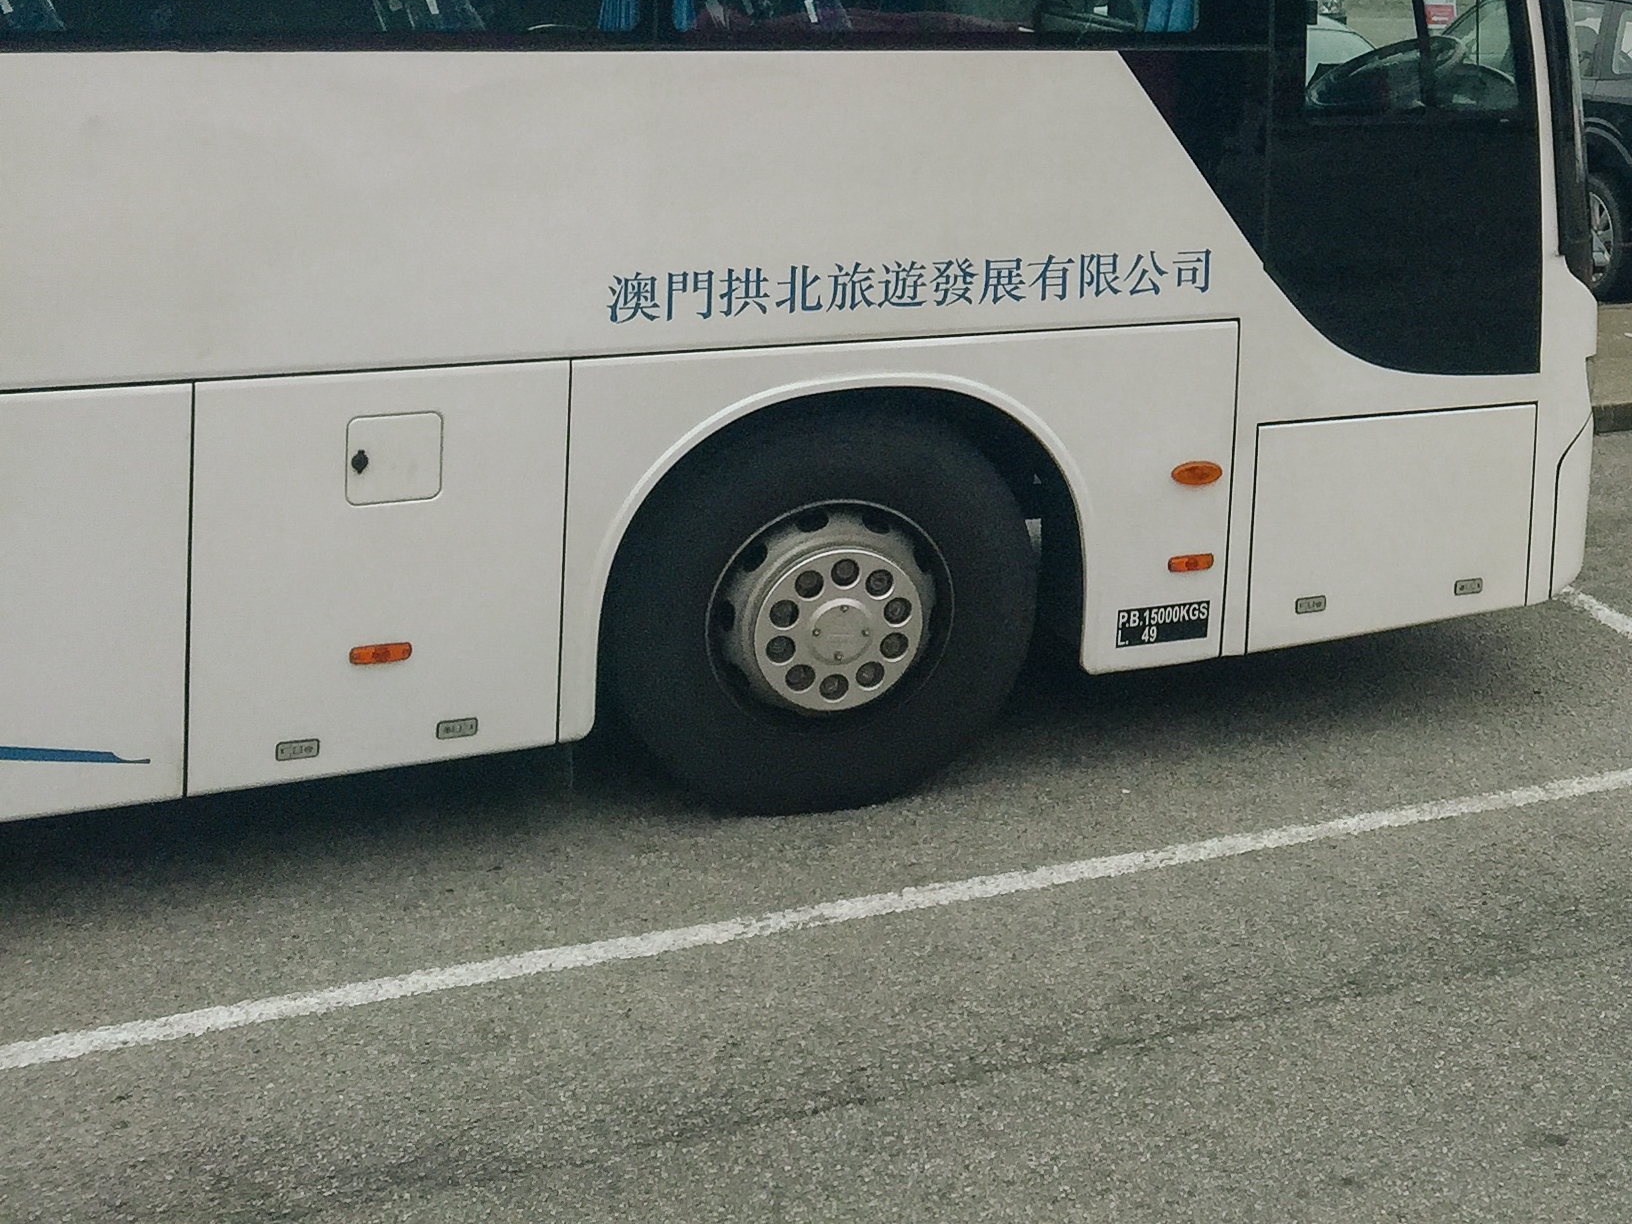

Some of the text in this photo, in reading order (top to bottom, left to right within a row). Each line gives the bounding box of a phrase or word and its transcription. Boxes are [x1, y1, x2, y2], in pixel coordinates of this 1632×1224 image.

[605, 248, 1212, 325] 澳門拱北旅遊發展有限公司
[1141, 625, 1157, 643] 49
